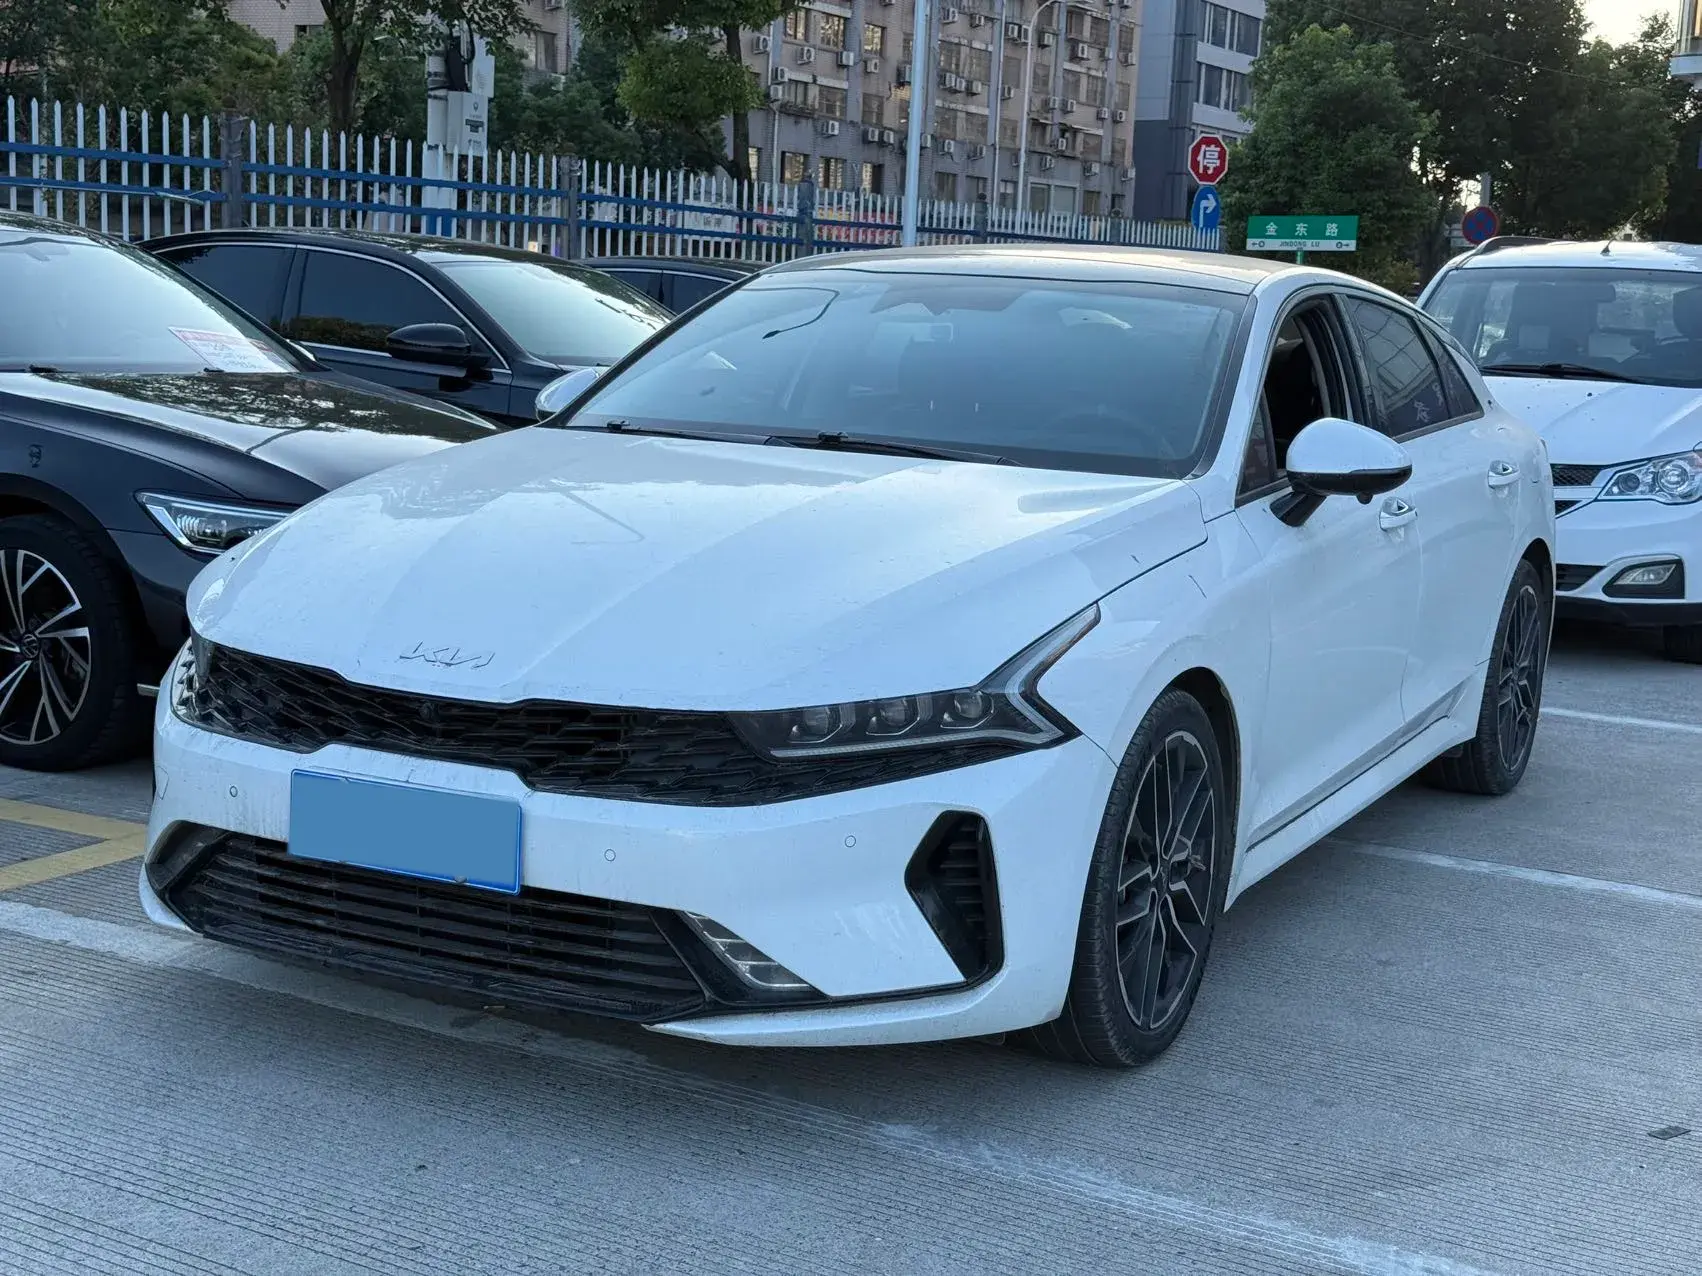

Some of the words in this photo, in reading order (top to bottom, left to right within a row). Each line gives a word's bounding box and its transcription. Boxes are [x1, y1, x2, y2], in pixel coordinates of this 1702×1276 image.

[1197, 144, 1220, 174] 停
[1265, 222, 1338, 237] 金东路
[1279, 240, 1307, 248] JINDONG
[1310, 240, 1320, 248] LU
